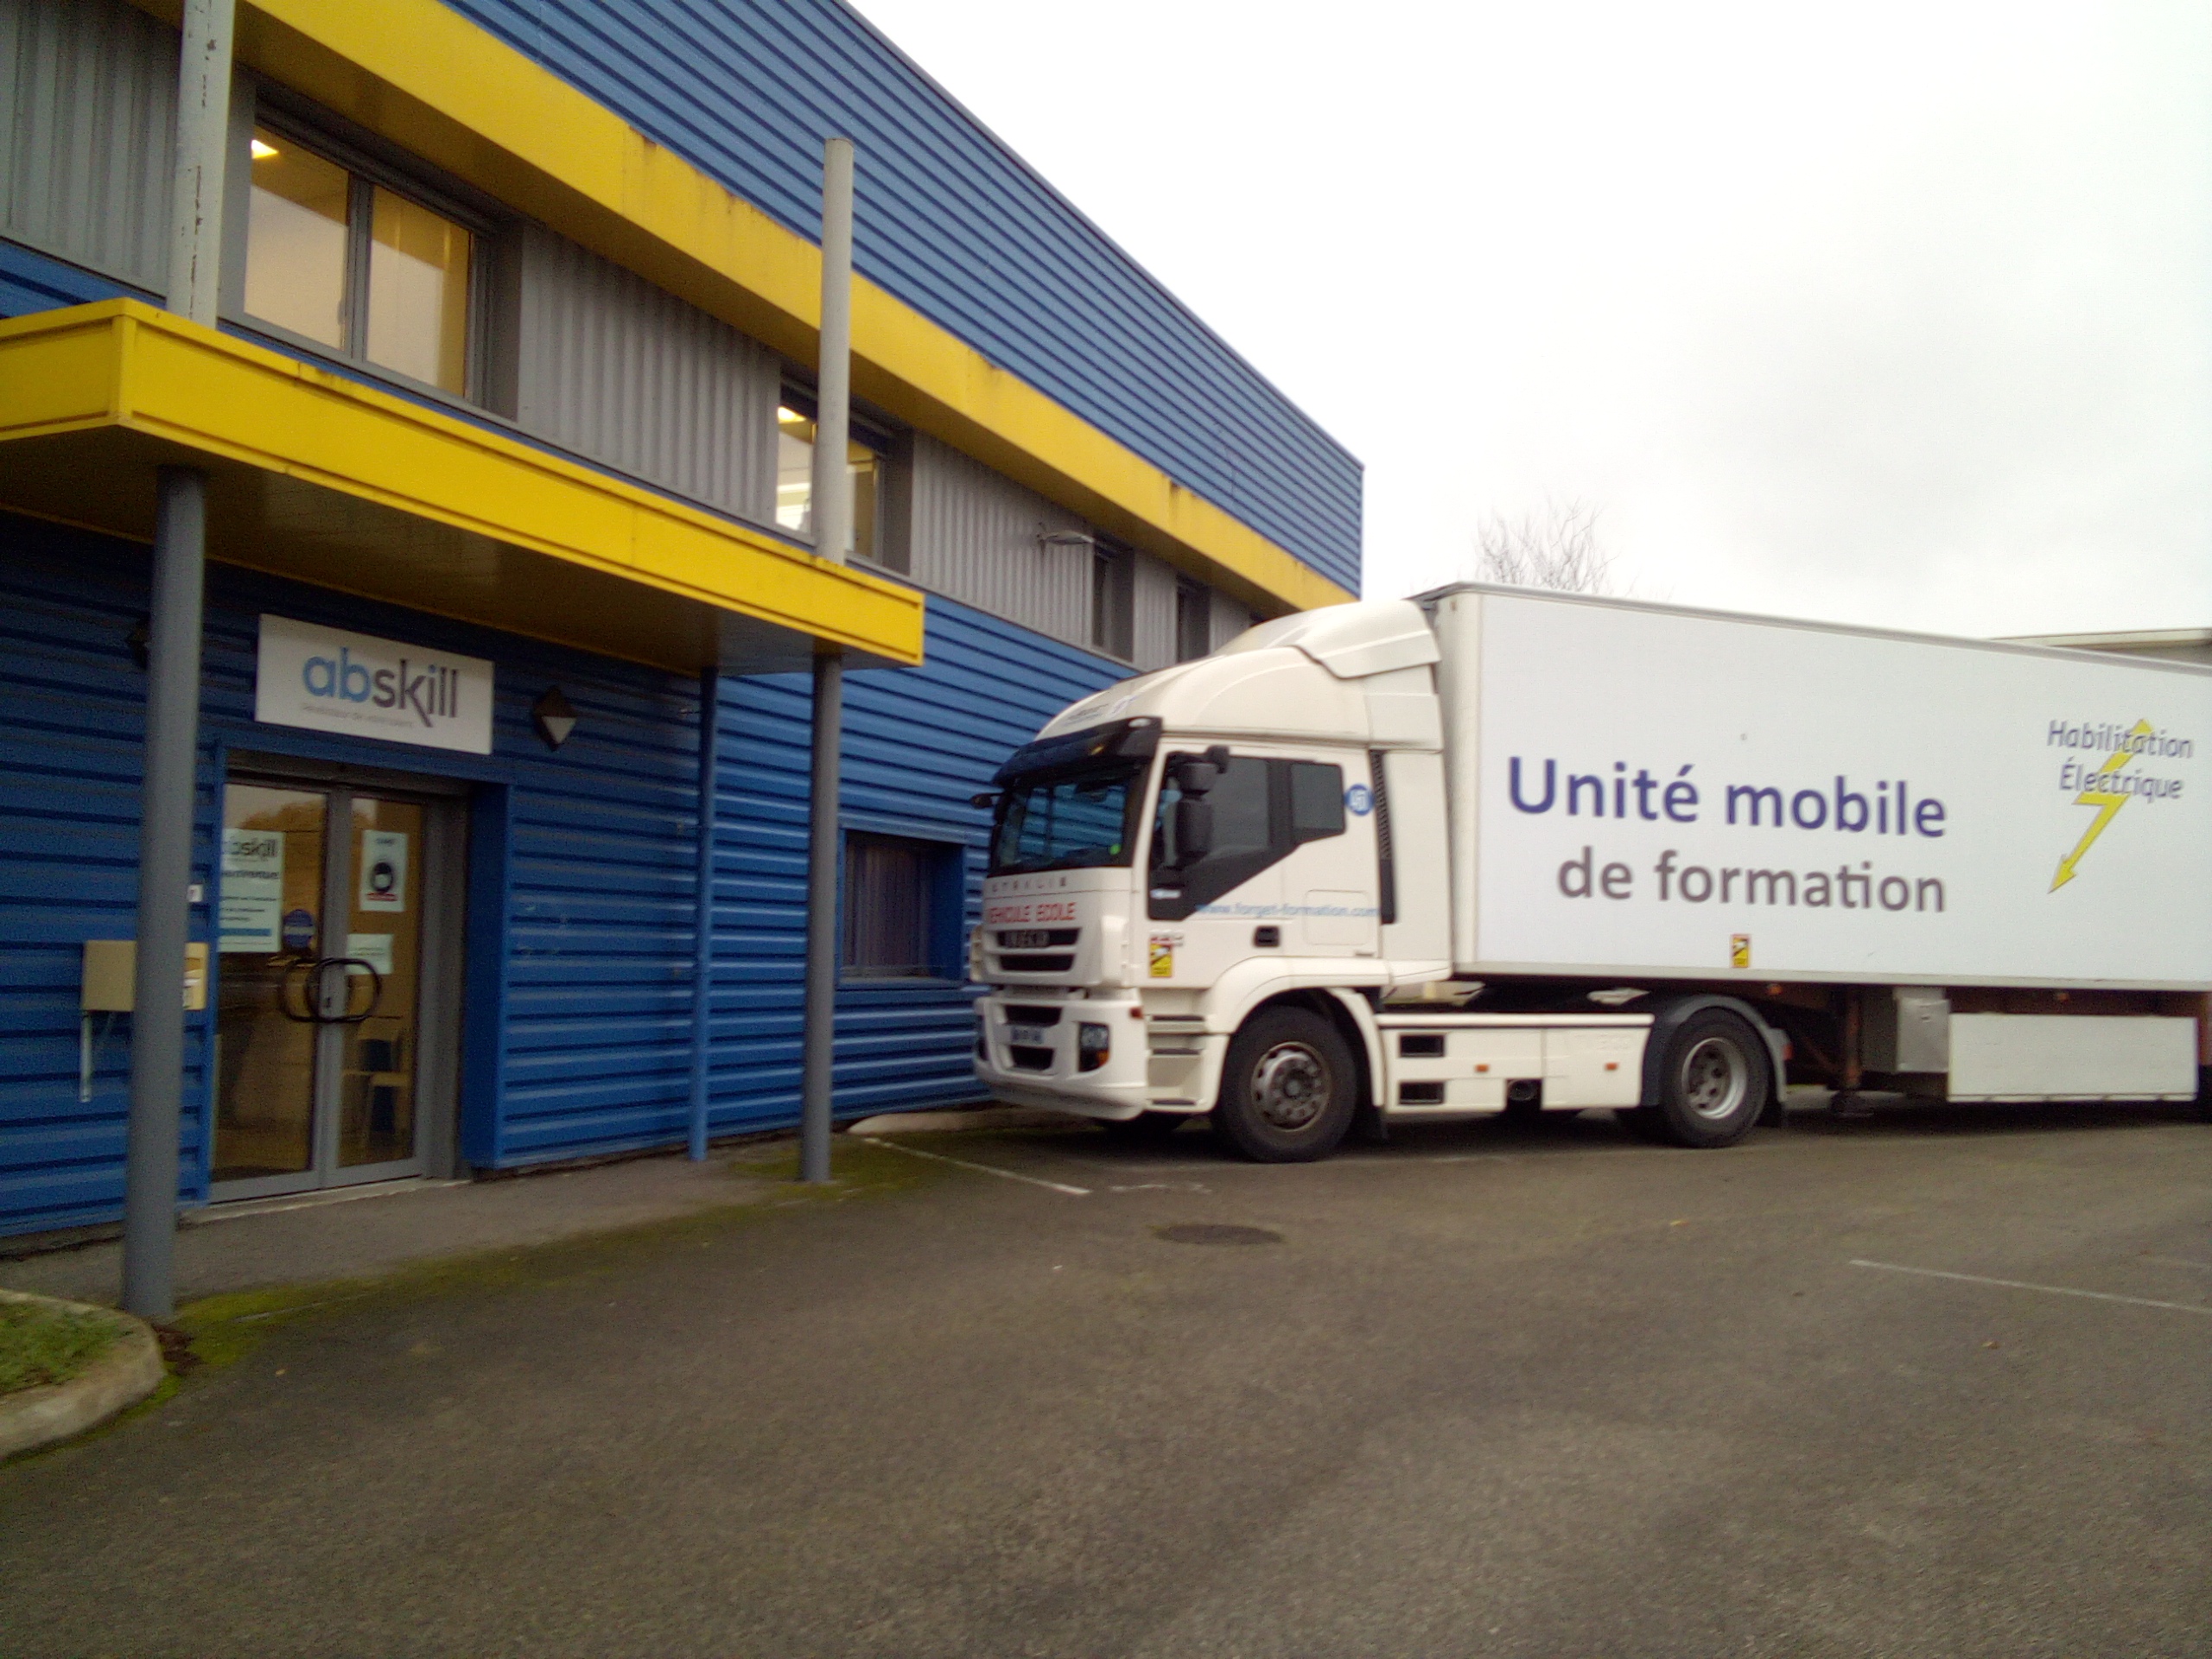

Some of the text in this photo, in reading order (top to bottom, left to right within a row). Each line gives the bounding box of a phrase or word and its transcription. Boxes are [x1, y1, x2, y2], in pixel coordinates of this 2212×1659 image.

[302, 646, 459, 728] abskill
[2047, 719, 2194, 759] Habilitation
[1509, 756, 1947, 838] Unité mobile
[2059, 756, 2183, 804] Électrique
[1558, 845, 1945, 912] de formation
